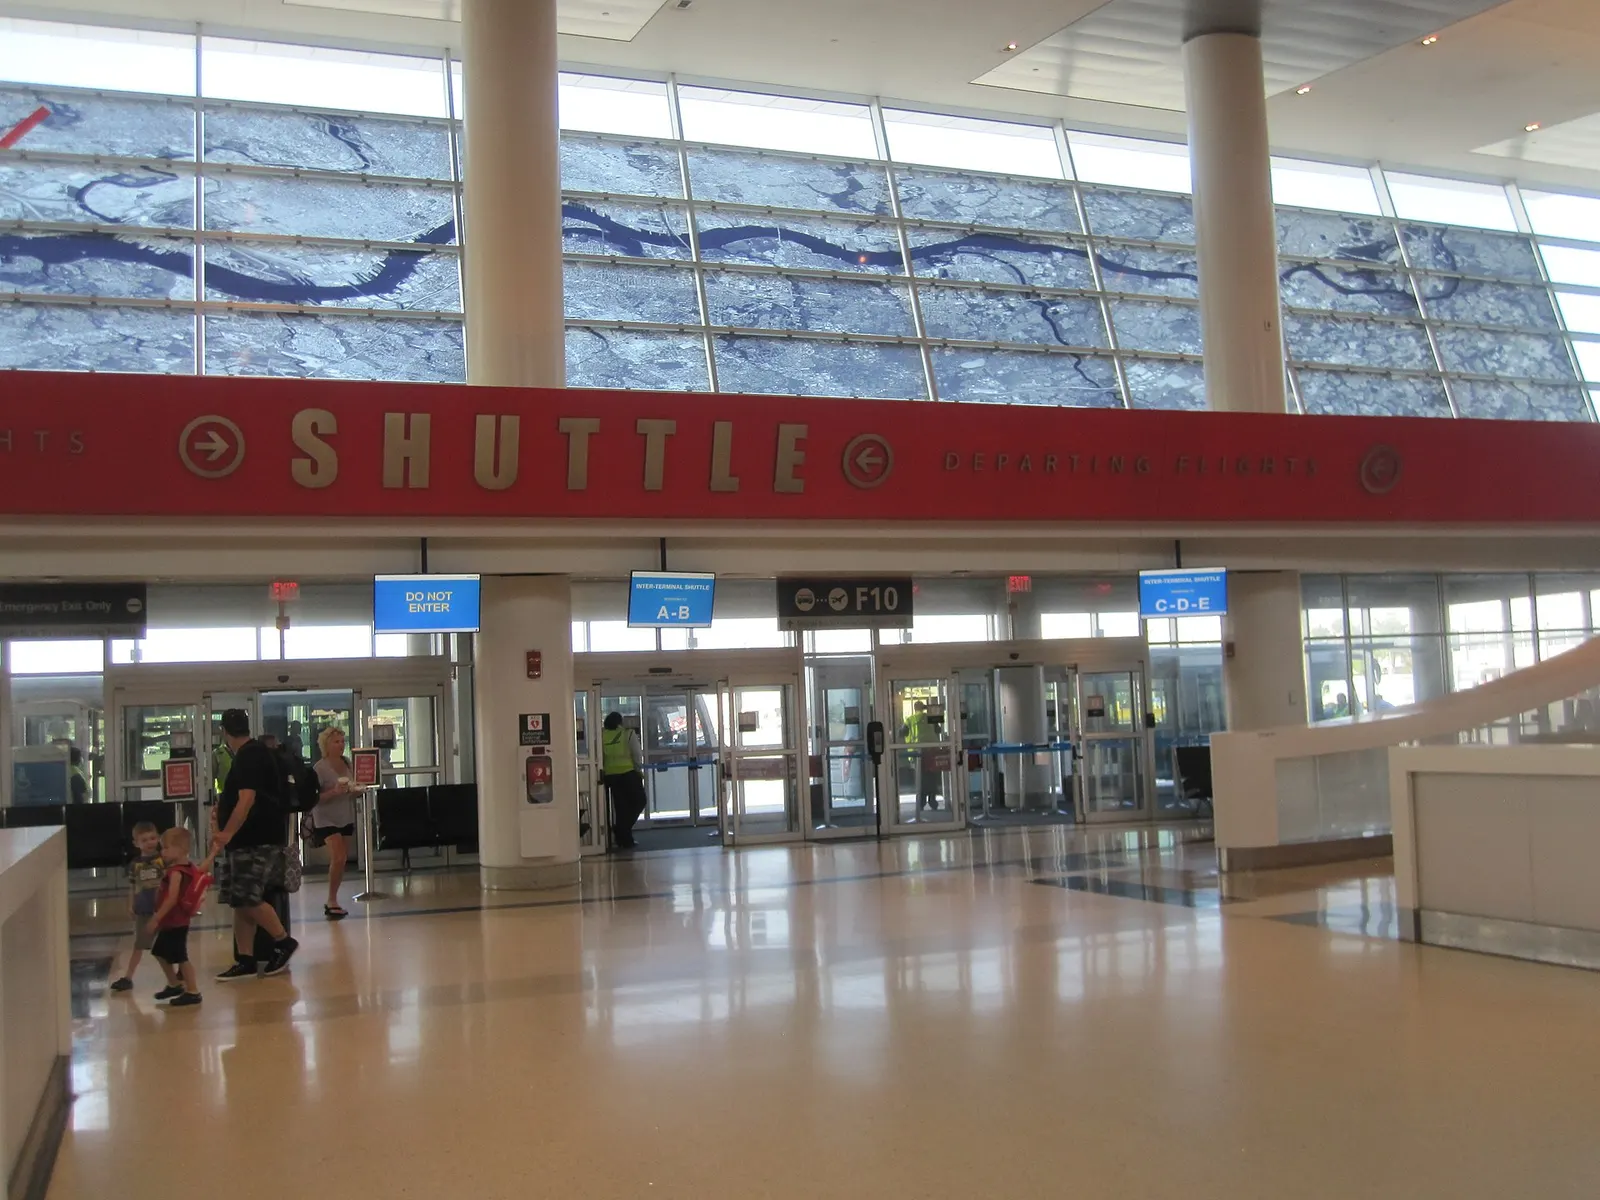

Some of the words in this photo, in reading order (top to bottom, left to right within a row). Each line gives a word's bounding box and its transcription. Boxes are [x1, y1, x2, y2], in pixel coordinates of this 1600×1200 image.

[290, 407, 808, 493] SHUTTLE
[944, 451, 1151, 475] DEPARTING
[1176, 455, 1319, 477] FLIGHTS
[405, 591, 424, 601] DO
[427, 591, 453, 601] NOT
[855, 586, 898, 611] F10
[61, 600, 83, 612] Exit
[85, 599, 112, 614] Only
[408, 602, 451, 613] ENTER
